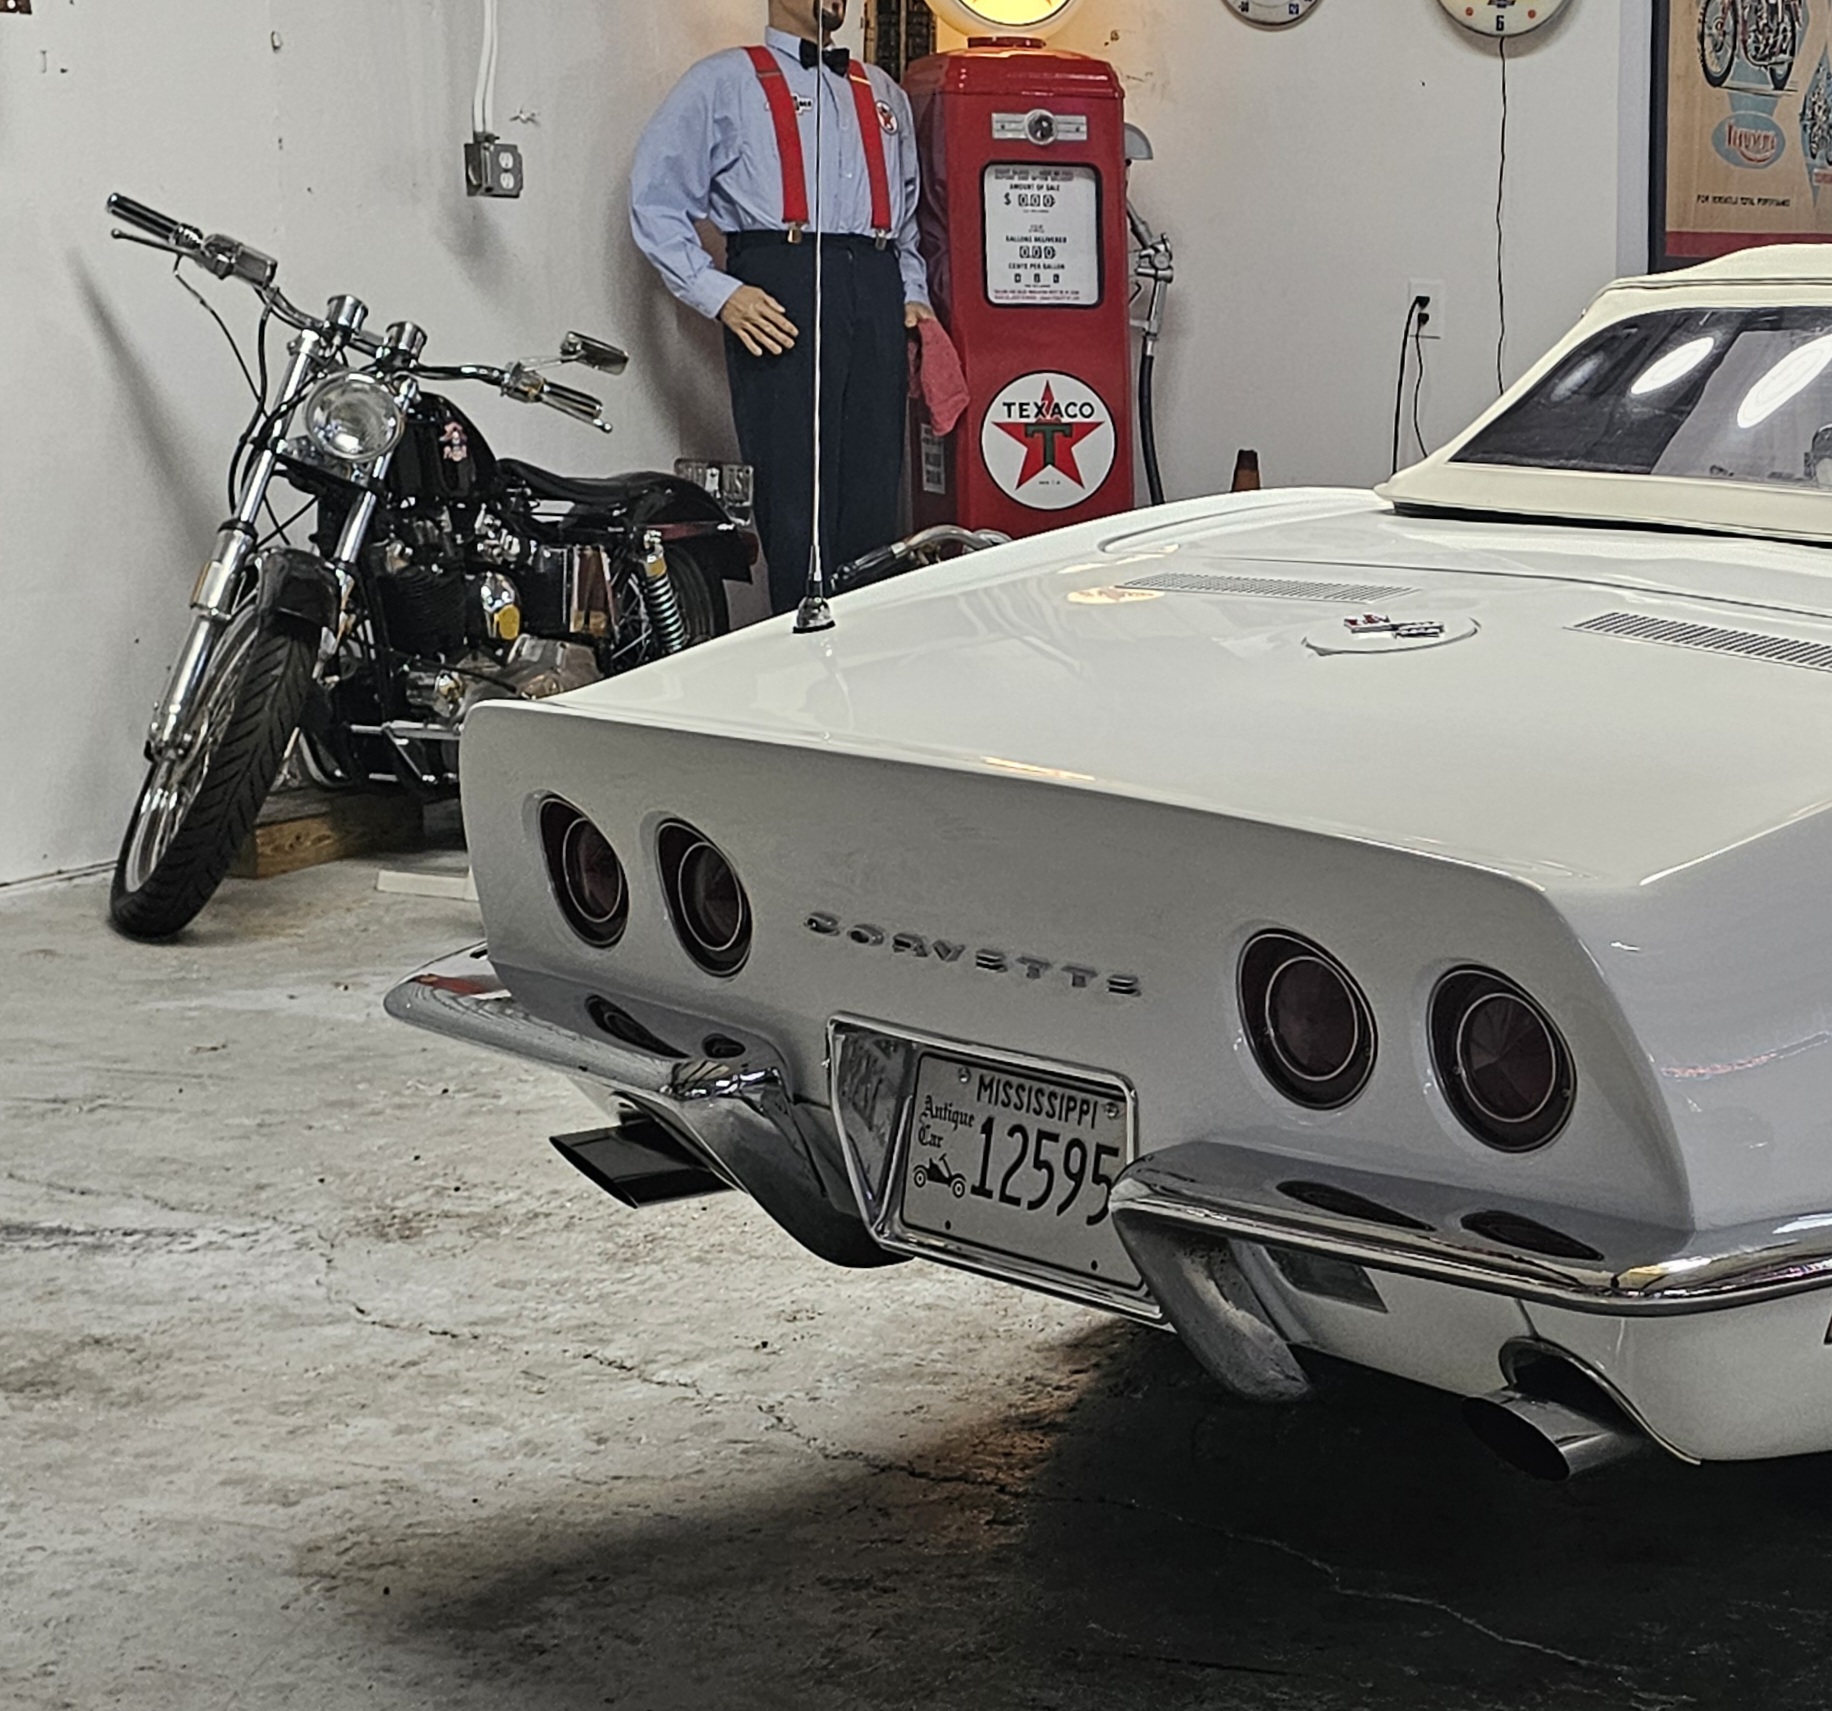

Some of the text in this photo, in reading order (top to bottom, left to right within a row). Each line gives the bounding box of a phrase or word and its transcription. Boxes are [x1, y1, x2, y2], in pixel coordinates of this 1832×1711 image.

[1496, 15, 1504, 31] 6
[1004, 192, 1012, 206] $
[1002, 402, 1095, 419] TEXACO
[805, 911, 1141, 997] CORVETTE
[922, 1095, 976, 1131] Antique
[976, 1074, 1099, 1129] MISSISSIPPI
[917, 1117, 945, 1149] Car
[970, 1115, 1120, 1226] 12595
